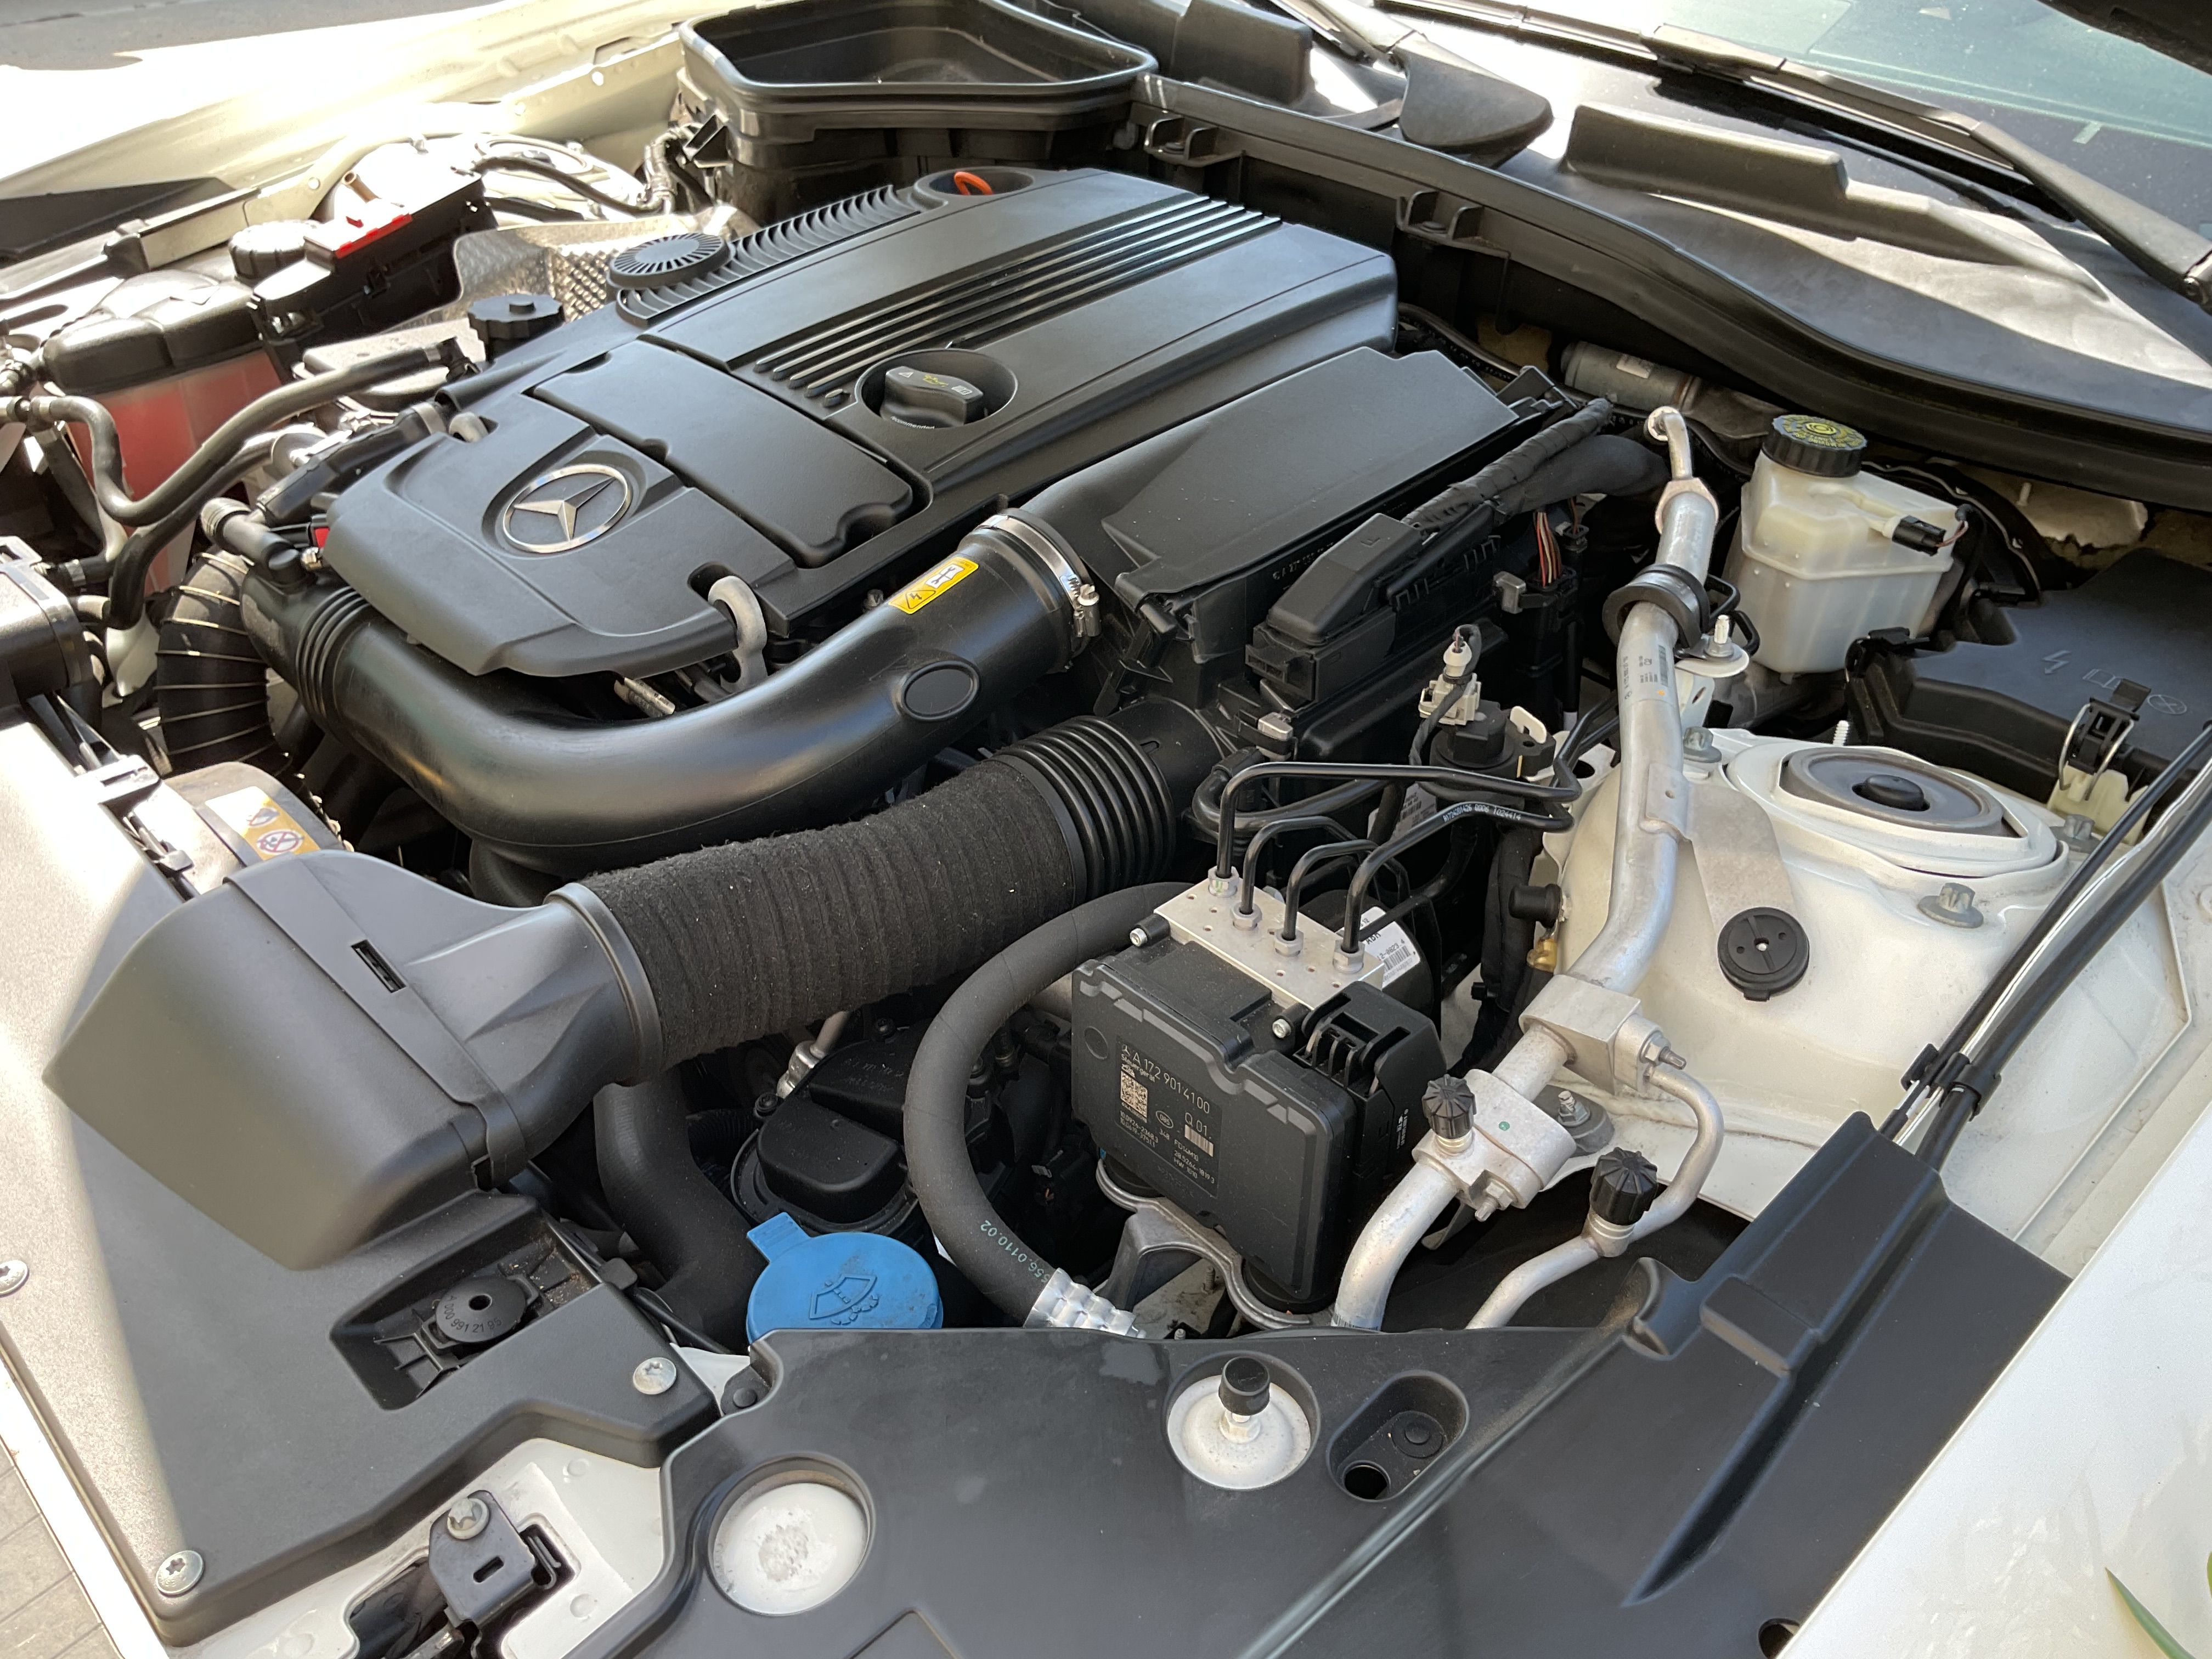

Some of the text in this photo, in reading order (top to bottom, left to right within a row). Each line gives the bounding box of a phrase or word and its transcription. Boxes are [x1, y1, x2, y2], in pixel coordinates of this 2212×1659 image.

[1132, 1052, 1141, 1066] A
[1144, 1059, 1161, 1080] 172
[444, 1304, 455, 1319] 000
[451, 1318, 470, 1333] 991
[472, 1323, 485, 1333] 21
